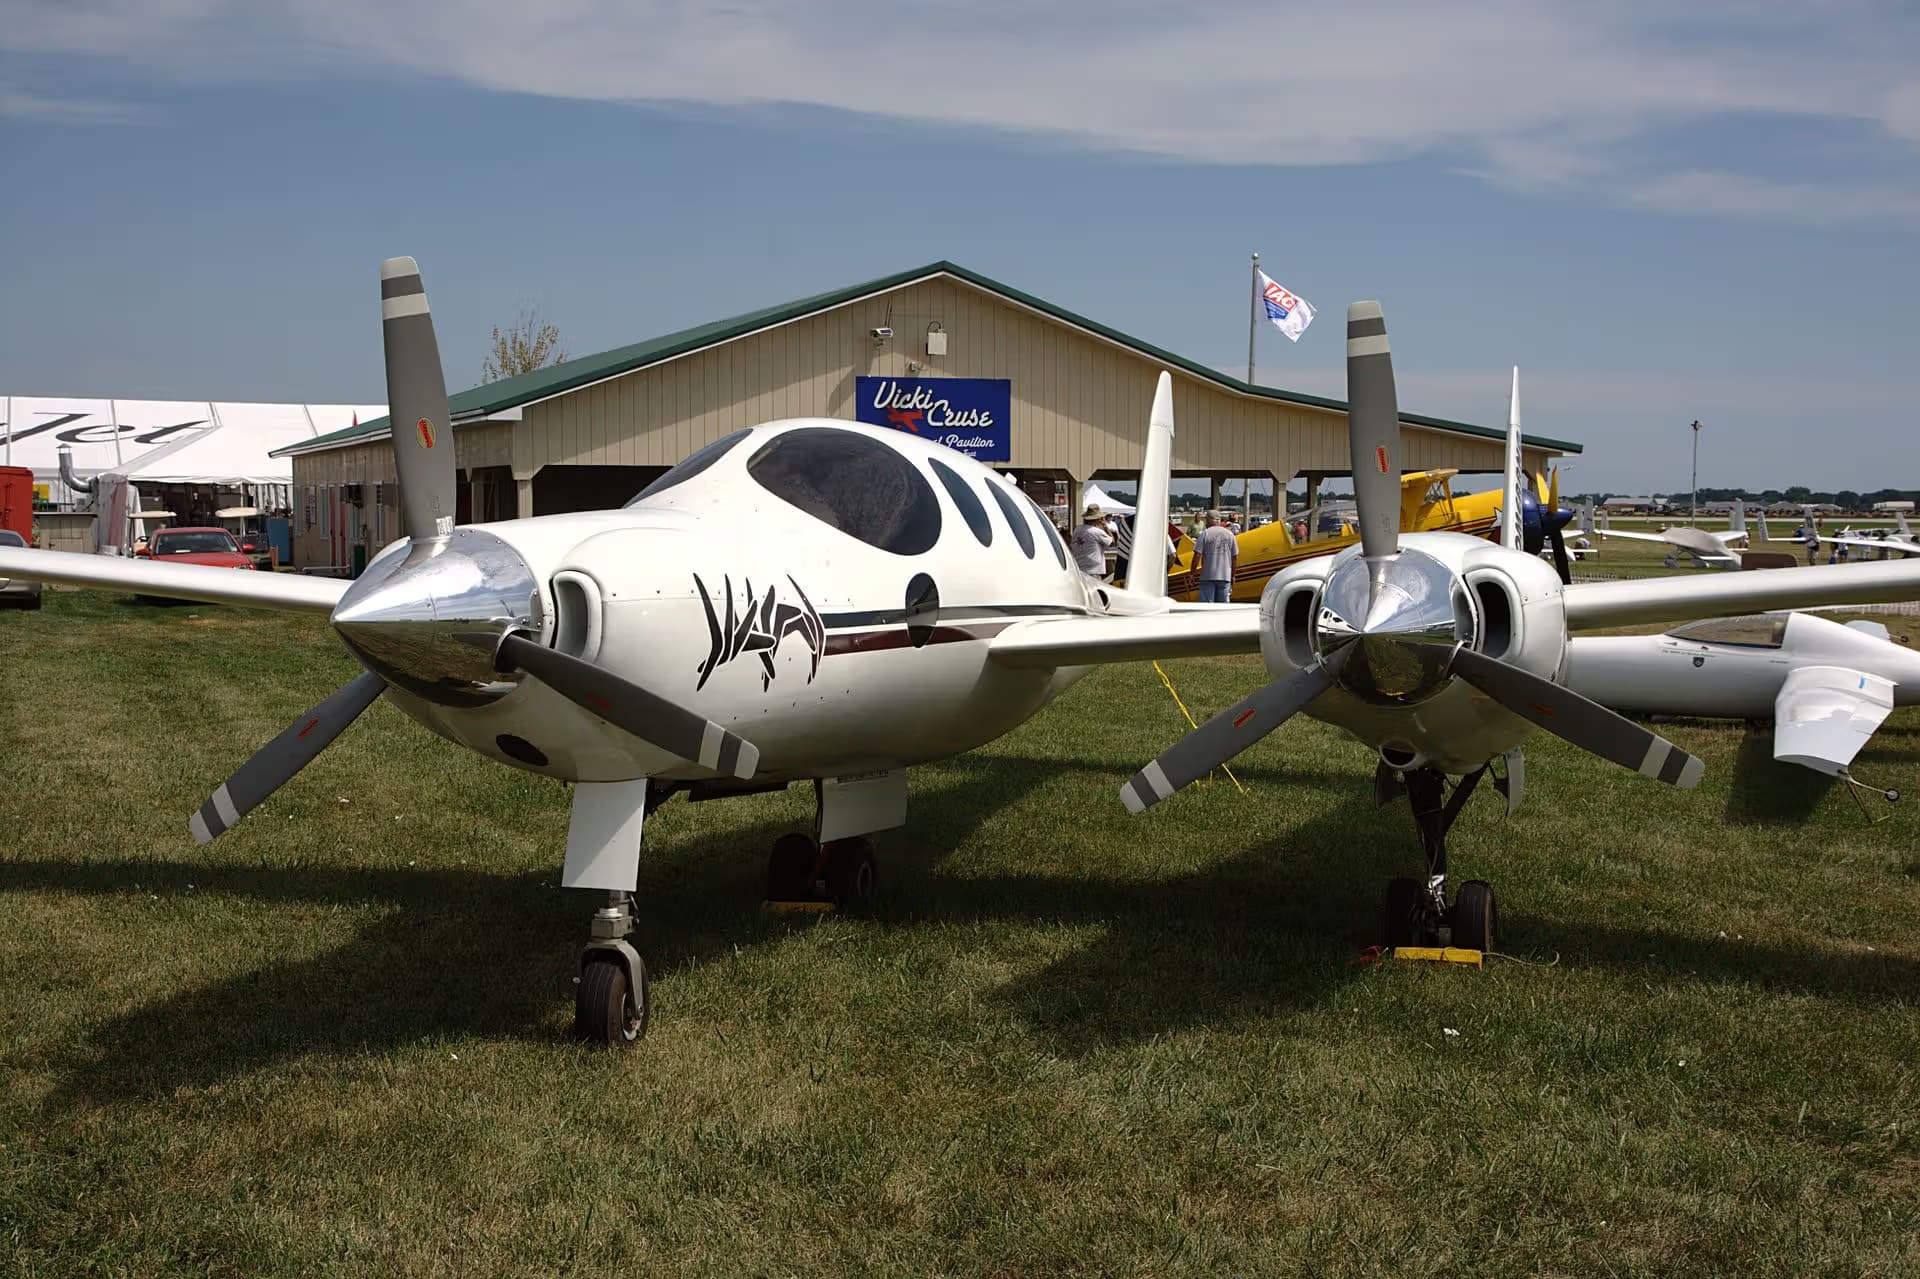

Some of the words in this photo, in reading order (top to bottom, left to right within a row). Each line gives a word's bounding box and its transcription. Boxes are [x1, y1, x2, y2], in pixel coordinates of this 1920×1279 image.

[873, 381, 933, 410] Vicki
[927, 399, 993, 427] Cruse
[945, 433, 995, 448] Pavilion
